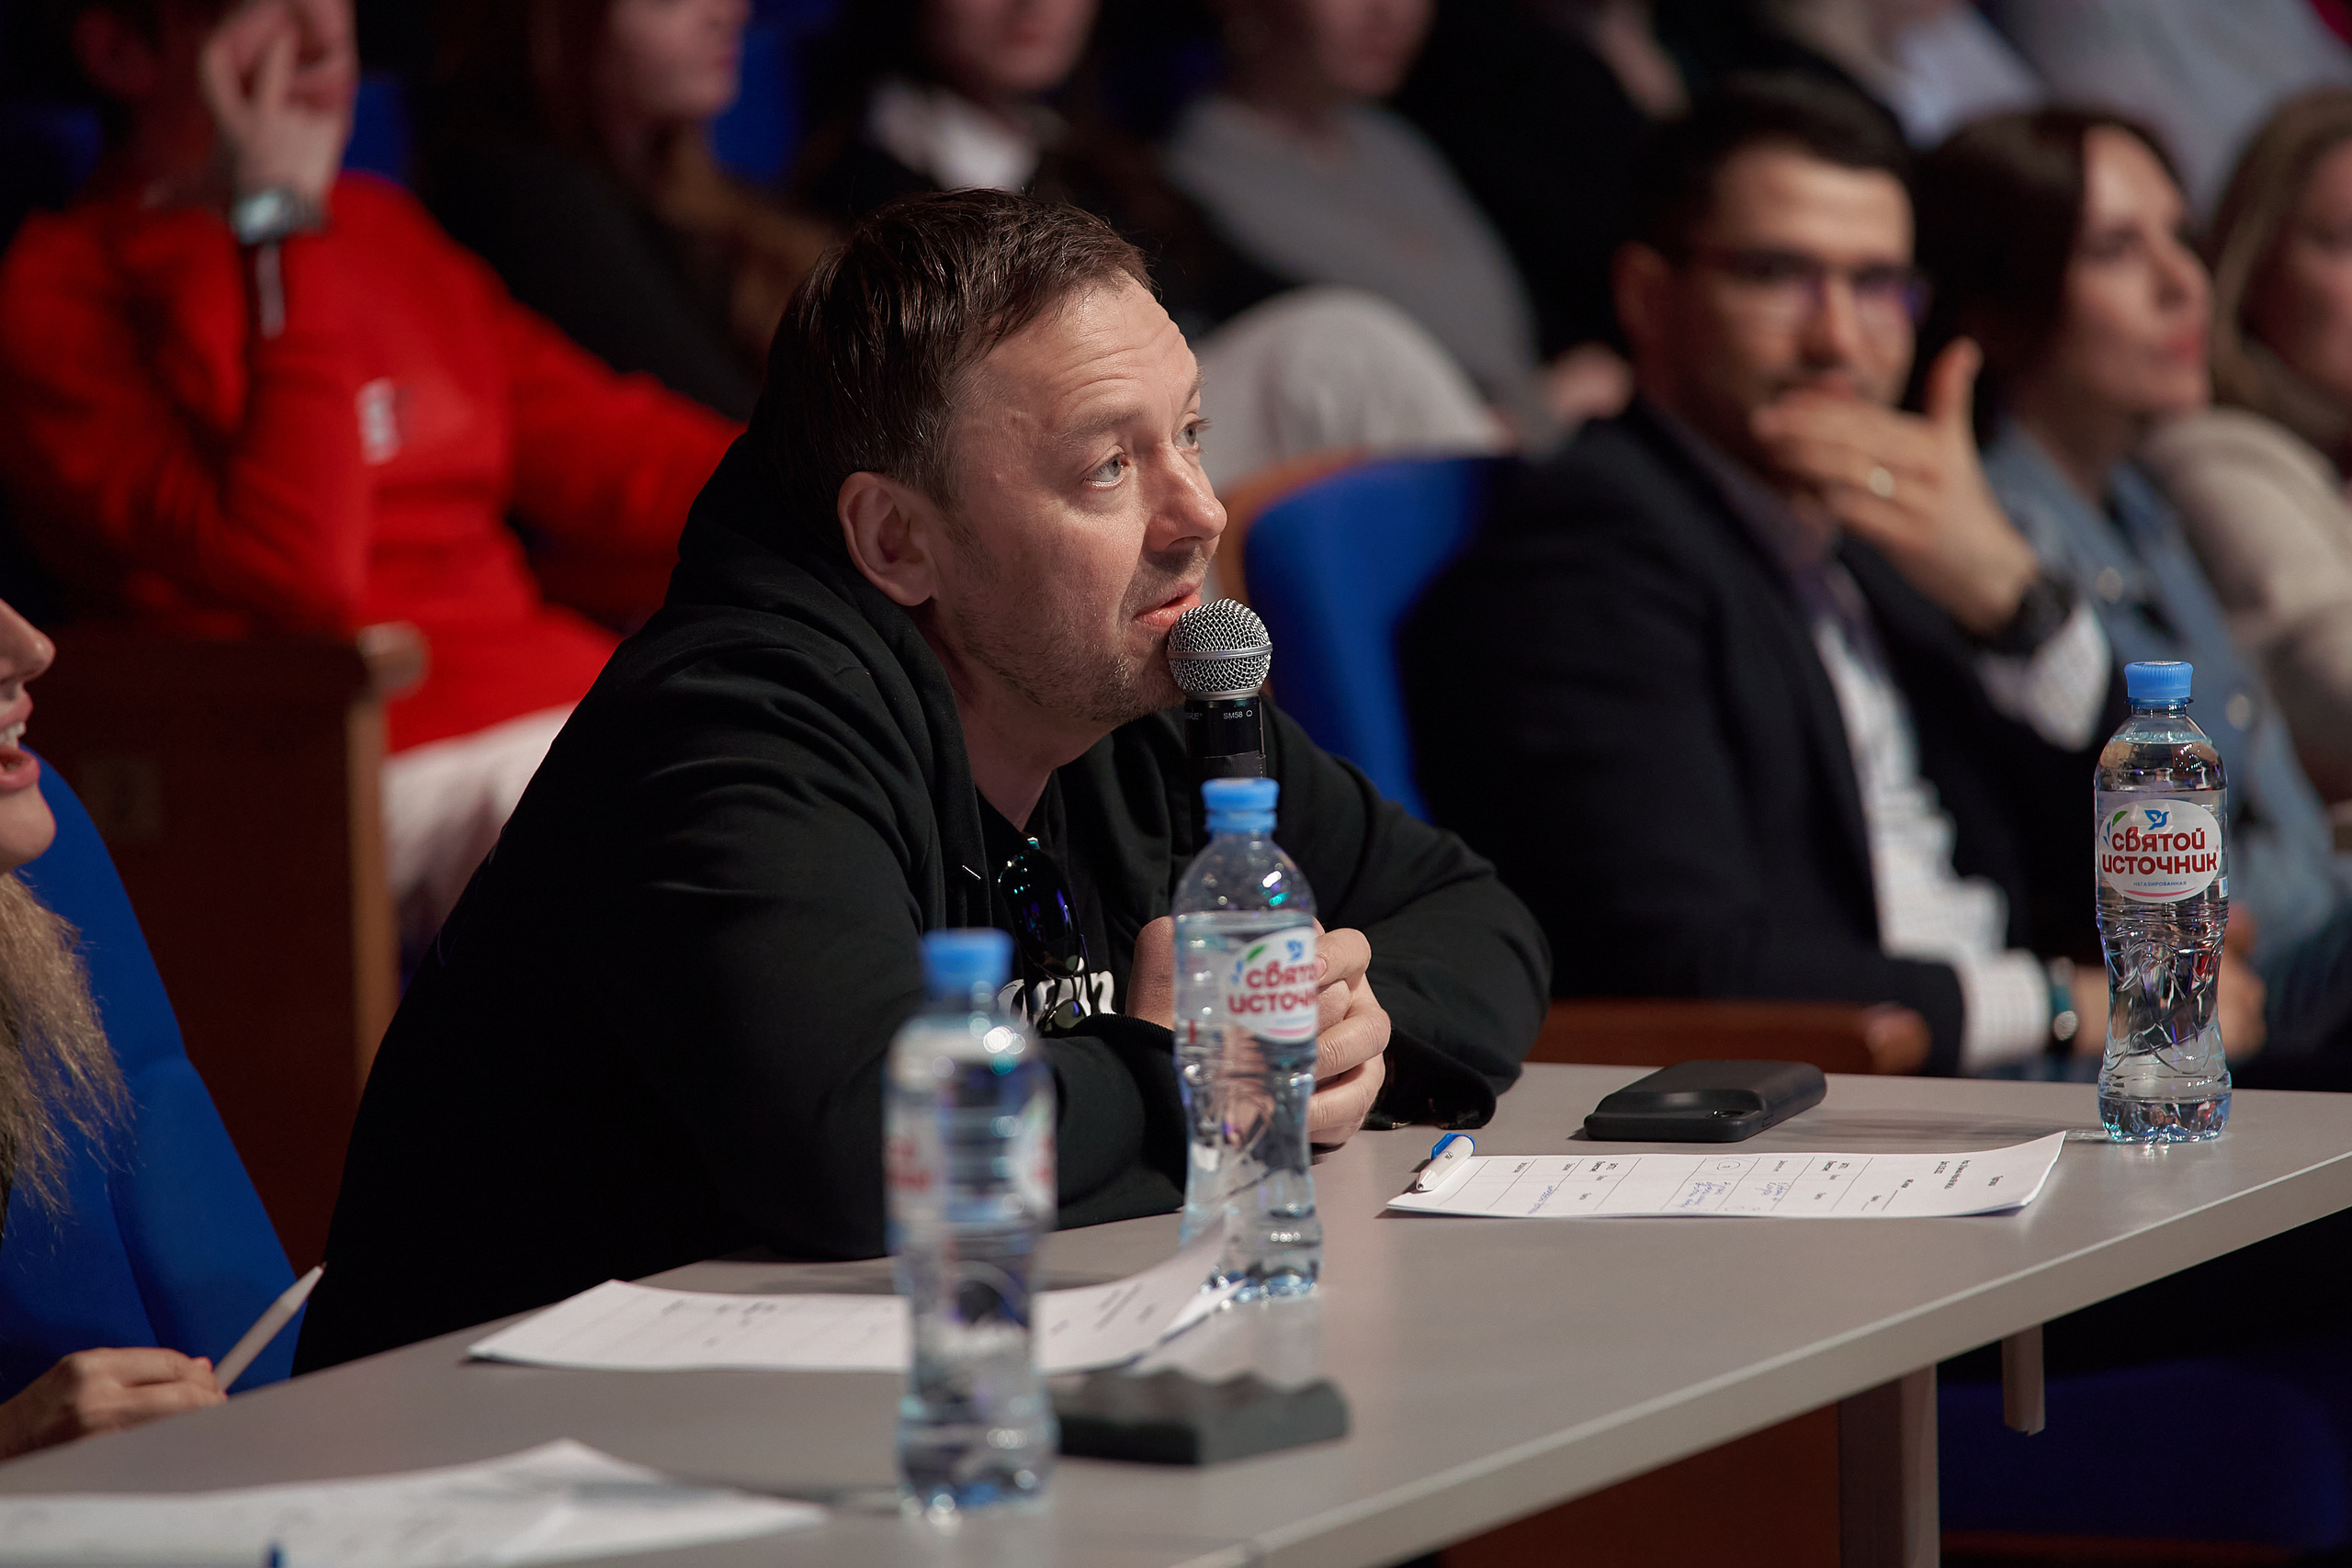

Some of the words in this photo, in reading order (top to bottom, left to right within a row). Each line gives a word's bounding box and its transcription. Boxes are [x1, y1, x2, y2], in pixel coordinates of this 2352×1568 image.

[1223, 711, 1243, 719] SM58
[2111, 826, 2206, 852] СВЯТОЙ
[2101, 852, 2218, 875] ИСТОЧНИК
